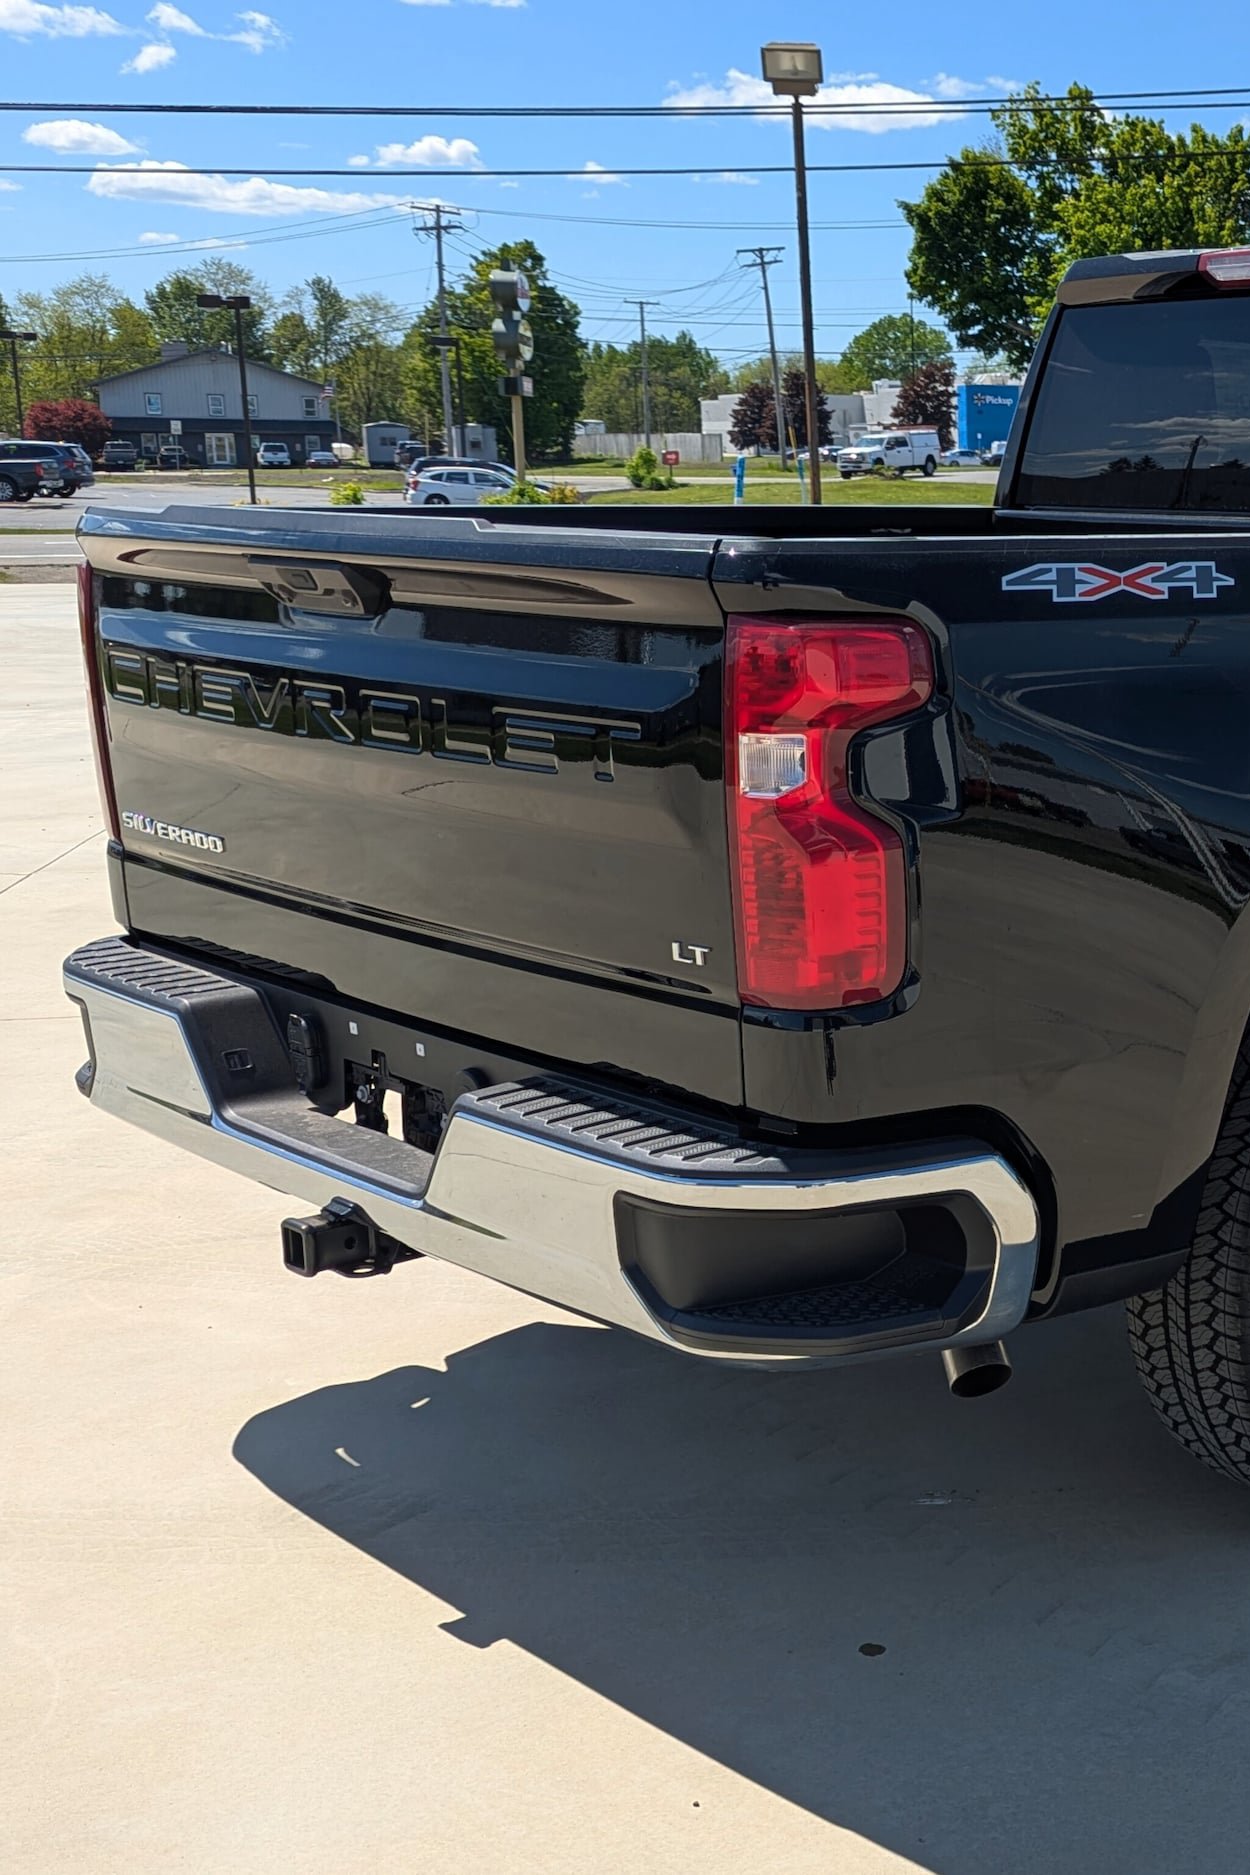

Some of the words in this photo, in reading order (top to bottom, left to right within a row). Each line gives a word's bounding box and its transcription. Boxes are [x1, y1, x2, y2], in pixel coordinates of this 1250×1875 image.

[986, 395, 1013, 406] Pickup
[107, 648, 642, 782] CHEVROLET
[121, 810, 225, 853] SILVERADO
[671, 941, 710, 966] LT
